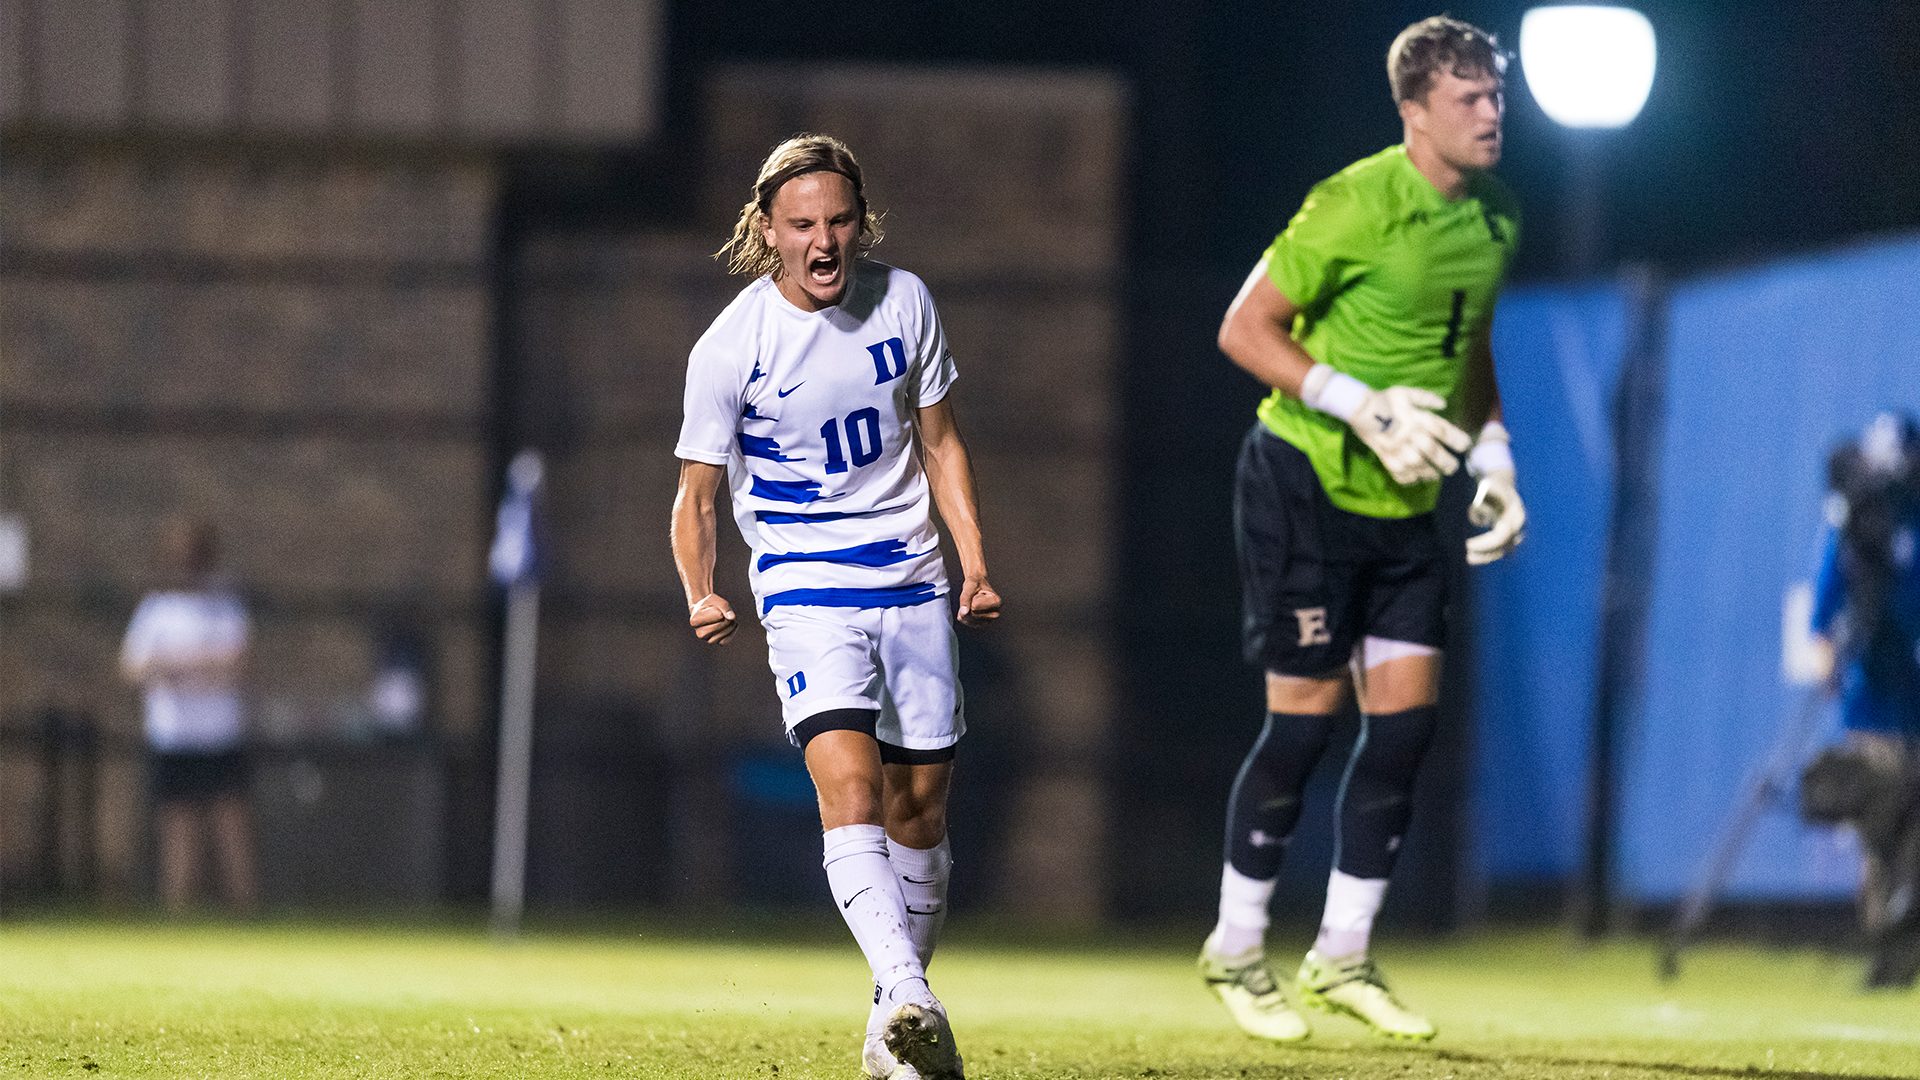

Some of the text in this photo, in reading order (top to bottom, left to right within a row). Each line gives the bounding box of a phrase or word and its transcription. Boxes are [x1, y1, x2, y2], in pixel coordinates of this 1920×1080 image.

[1442, 288, 1466, 358] 1
[819, 406, 883, 475] 10
[1294, 607, 1331, 647] E
